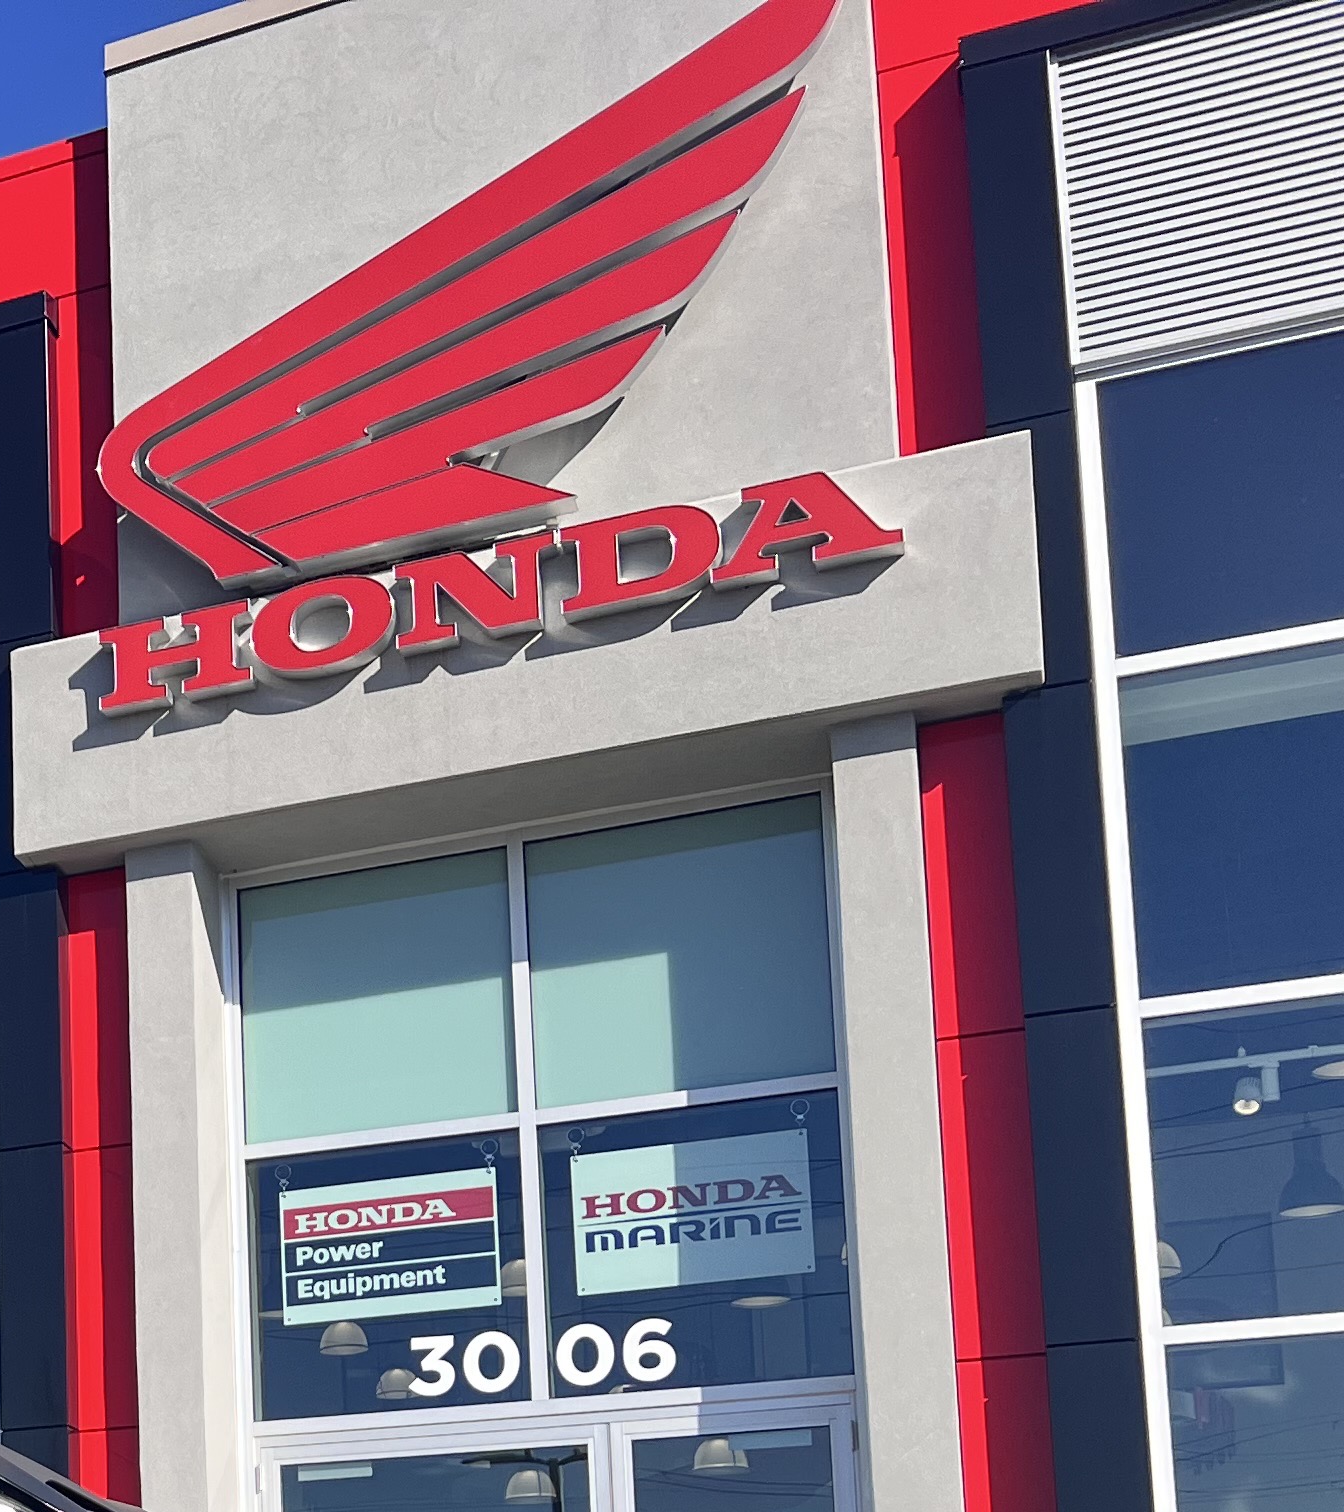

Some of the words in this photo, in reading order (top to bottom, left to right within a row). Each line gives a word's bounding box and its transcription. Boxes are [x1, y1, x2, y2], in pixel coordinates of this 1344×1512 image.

[99, 472, 904, 714] HONDA
[581, 1173, 802, 1219] HONDA
[293, 1197, 457, 1236] HONDA
[295, 1238, 385, 1267] Power
[296, 1263, 447, 1301] Equipment
